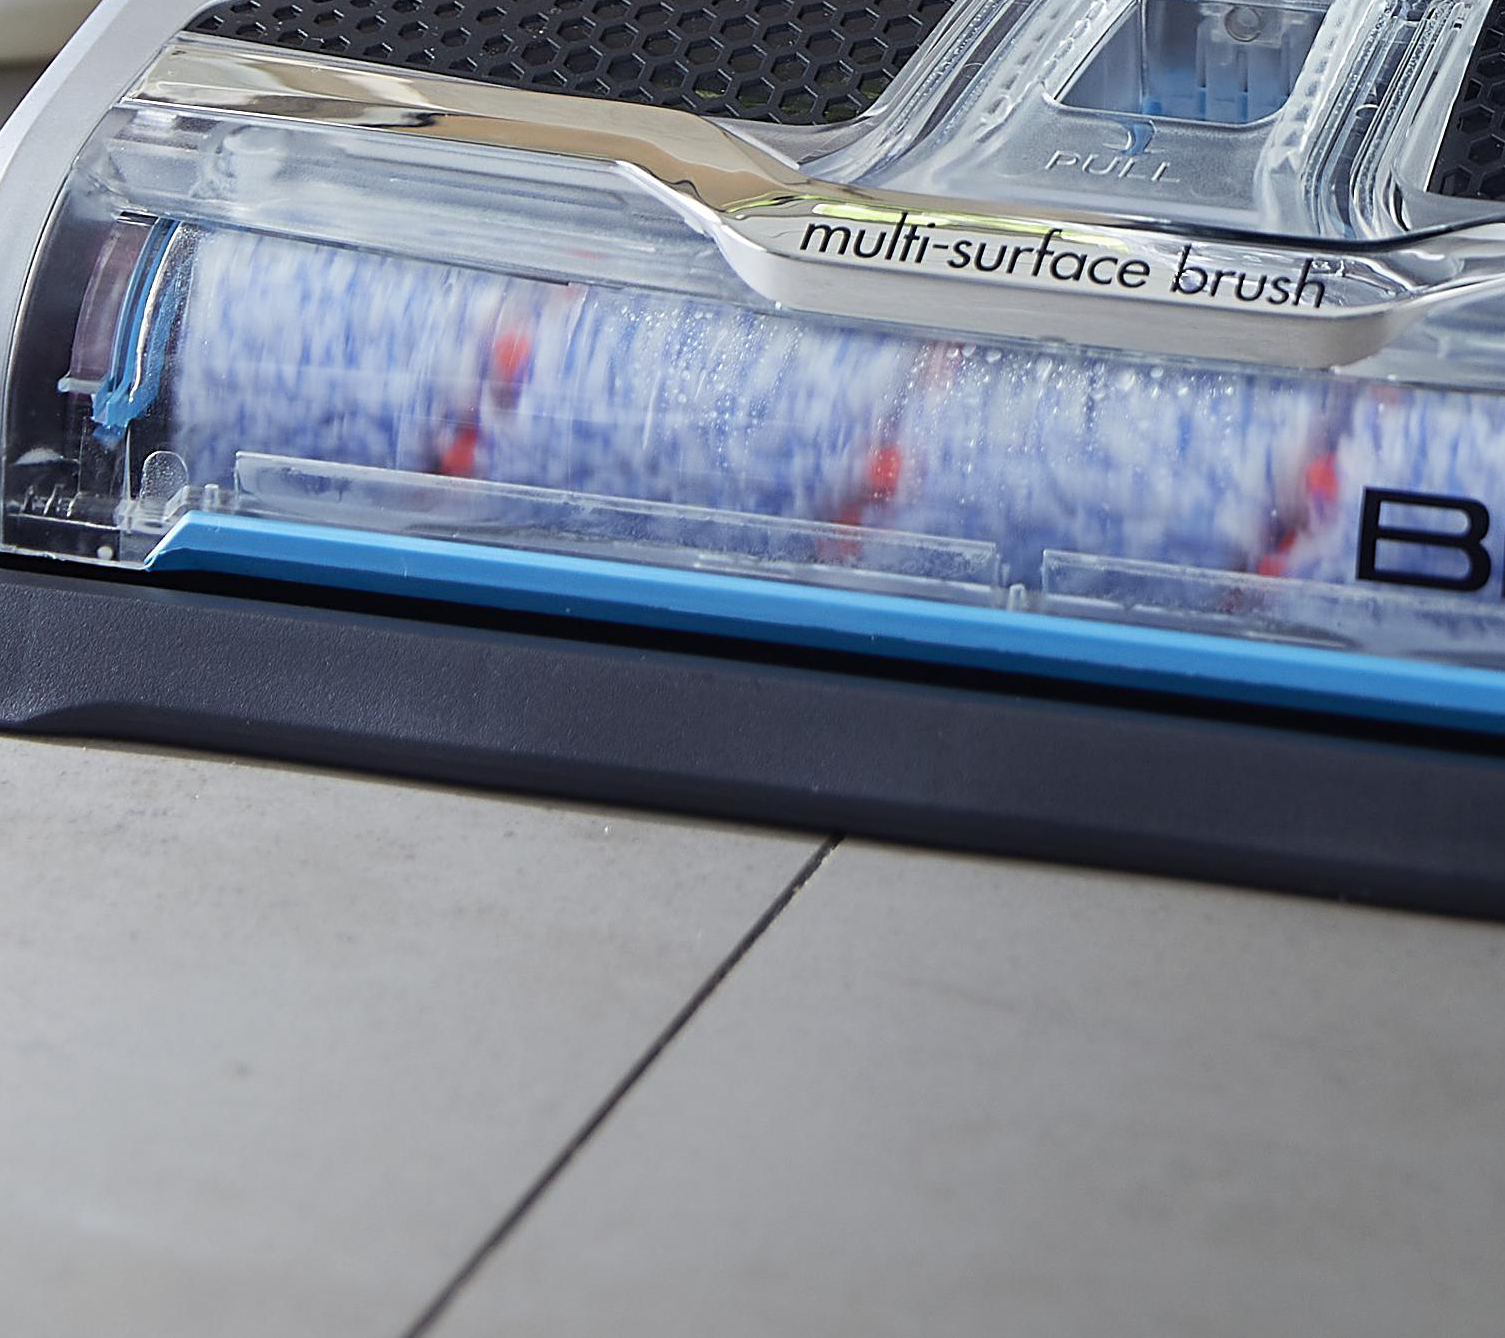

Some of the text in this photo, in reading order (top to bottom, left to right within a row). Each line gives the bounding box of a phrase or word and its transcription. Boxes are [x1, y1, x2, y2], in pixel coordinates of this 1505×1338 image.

[1044, 149, 1181, 184] PULL
[798, 211, 1328, 310] multi-surface brush
